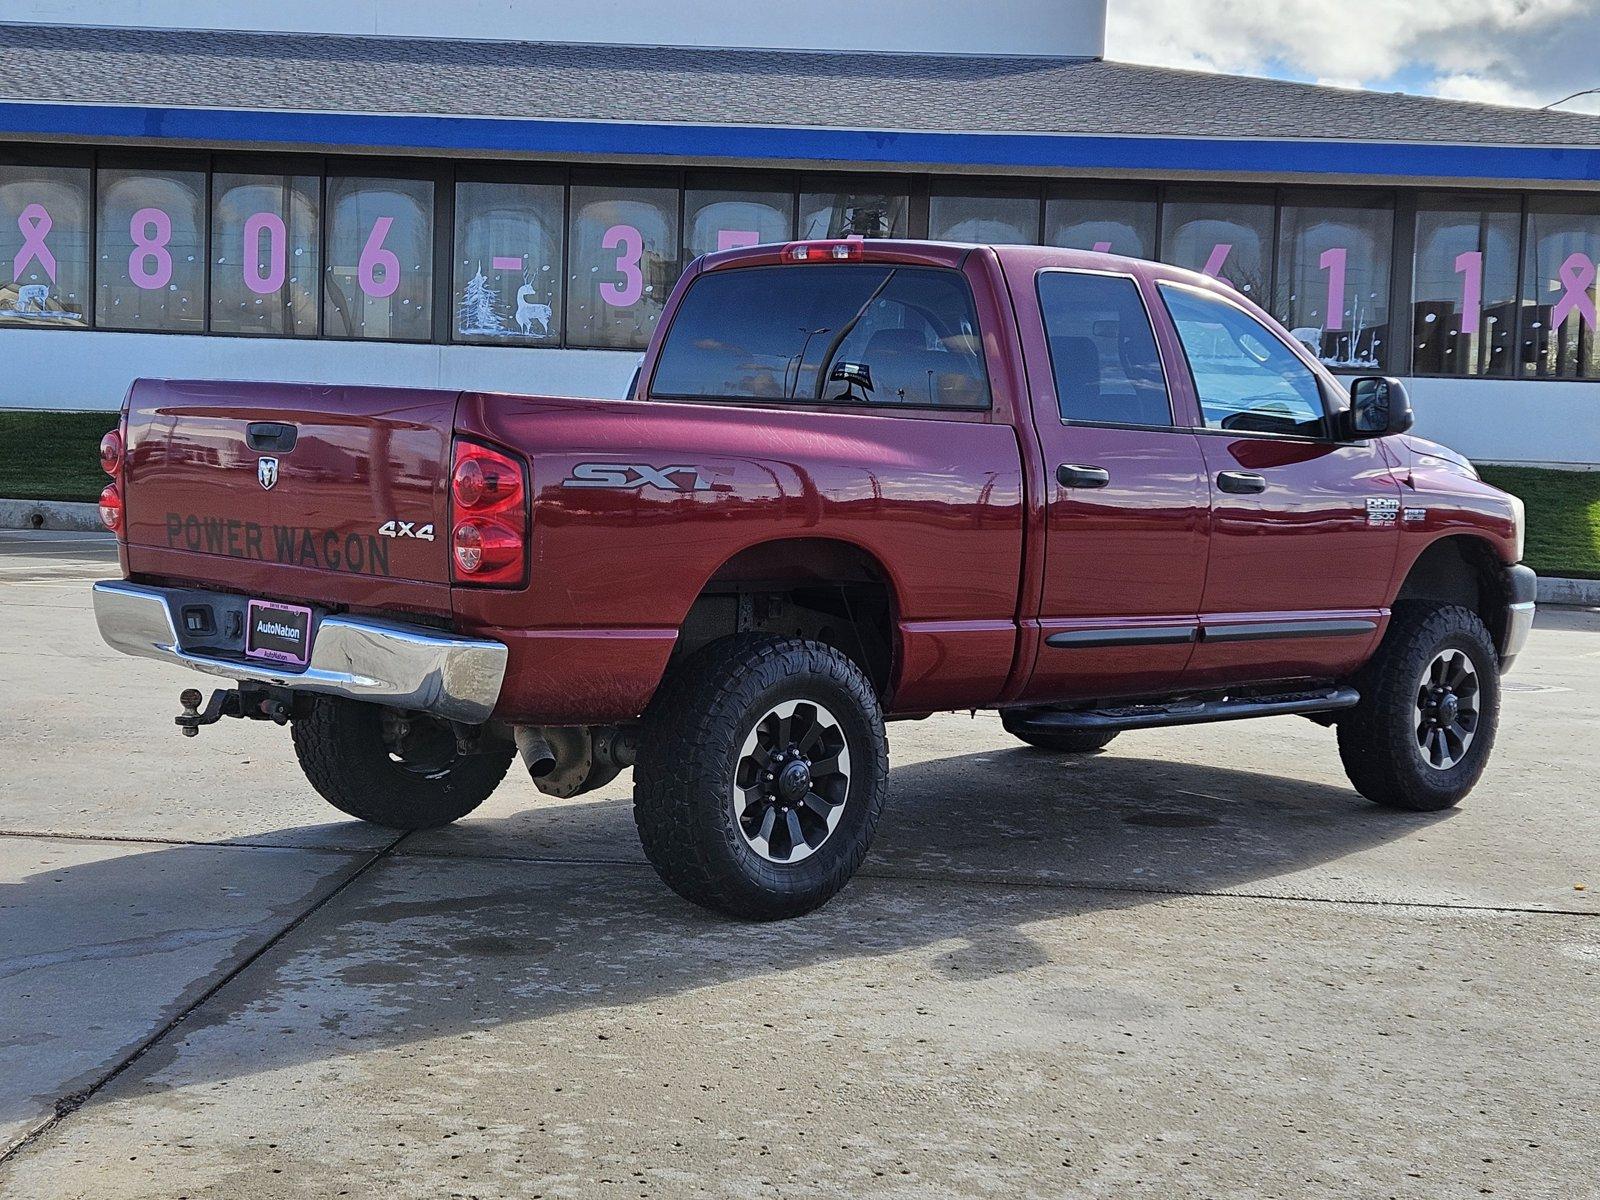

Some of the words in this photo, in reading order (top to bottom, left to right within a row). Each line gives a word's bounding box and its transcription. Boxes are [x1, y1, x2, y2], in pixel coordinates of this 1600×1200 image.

[129, 208, 172, 289] 8
[358, 217, 400, 298] 6
[600, 225, 643, 306] 3
[1320, 248, 1347, 330] 1
[1455, 251, 1482, 333] 1
[1368, 512, 1397, 520] 2500
[165, 512, 264, 560] POWER
[273, 524, 390, 576] WAGON
[256, 620, 300, 639] AutoNation
[263, 650, 288, 661] AutoNation
